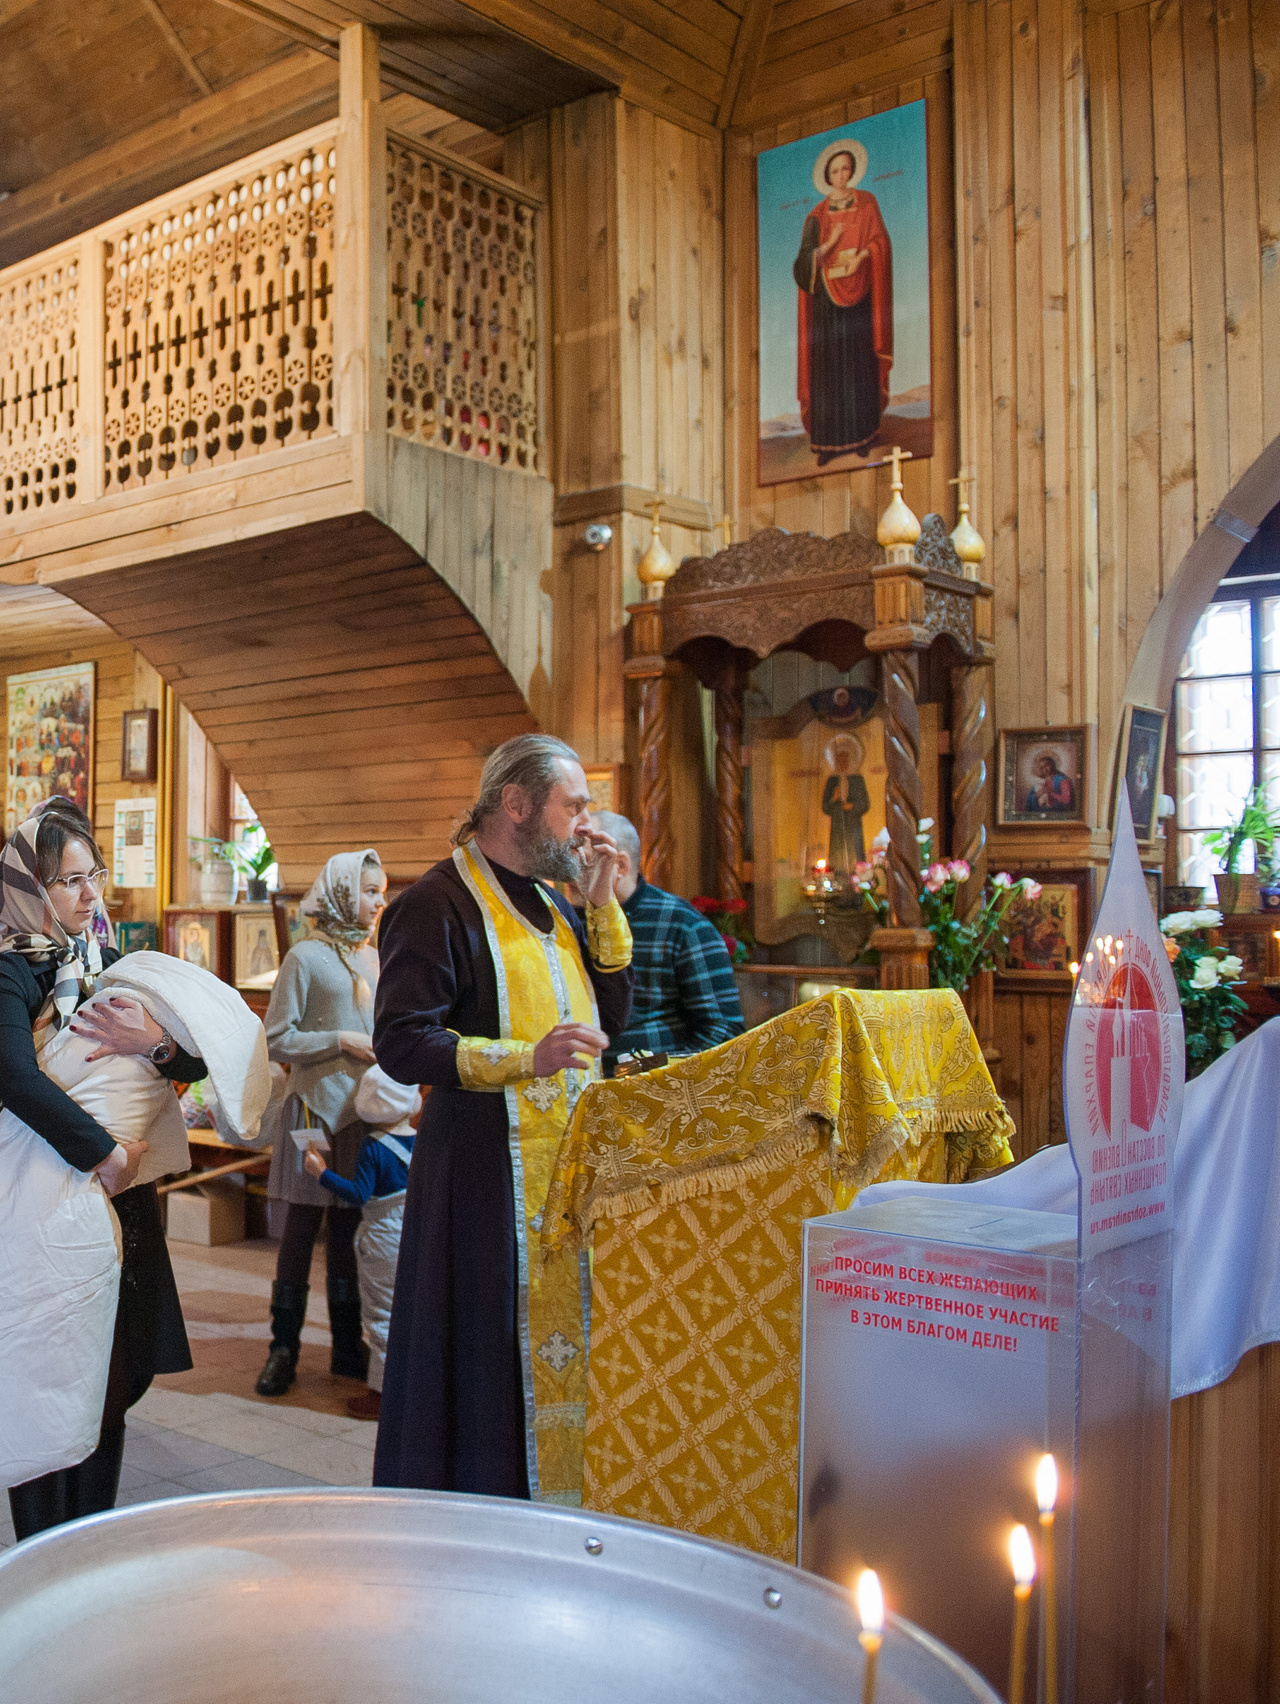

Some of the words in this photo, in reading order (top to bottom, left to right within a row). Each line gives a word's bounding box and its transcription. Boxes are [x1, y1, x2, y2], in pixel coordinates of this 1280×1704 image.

[835, 1256, 894, 1279] ПРОСИМ
[898, 1266, 935, 1286] ВСЕХ
[939, 1272, 1038, 1302] ЖЕЛАЮЩИХ
[815, 1278, 880, 1303] ПРИНЯТЬ
[883, 1289, 985, 1320] ЖЕРТВЕННОЕ
[988, 1306, 1059, 1333] УЧАСТИЕ
[850, 1309, 860, 1324] В
[863, 1311, 903, 1332] ЭТОМ
[907, 1319, 968, 1344] БЛАГОМ
[971, 1330, 1018, 1353] ДЕЛЕ!
